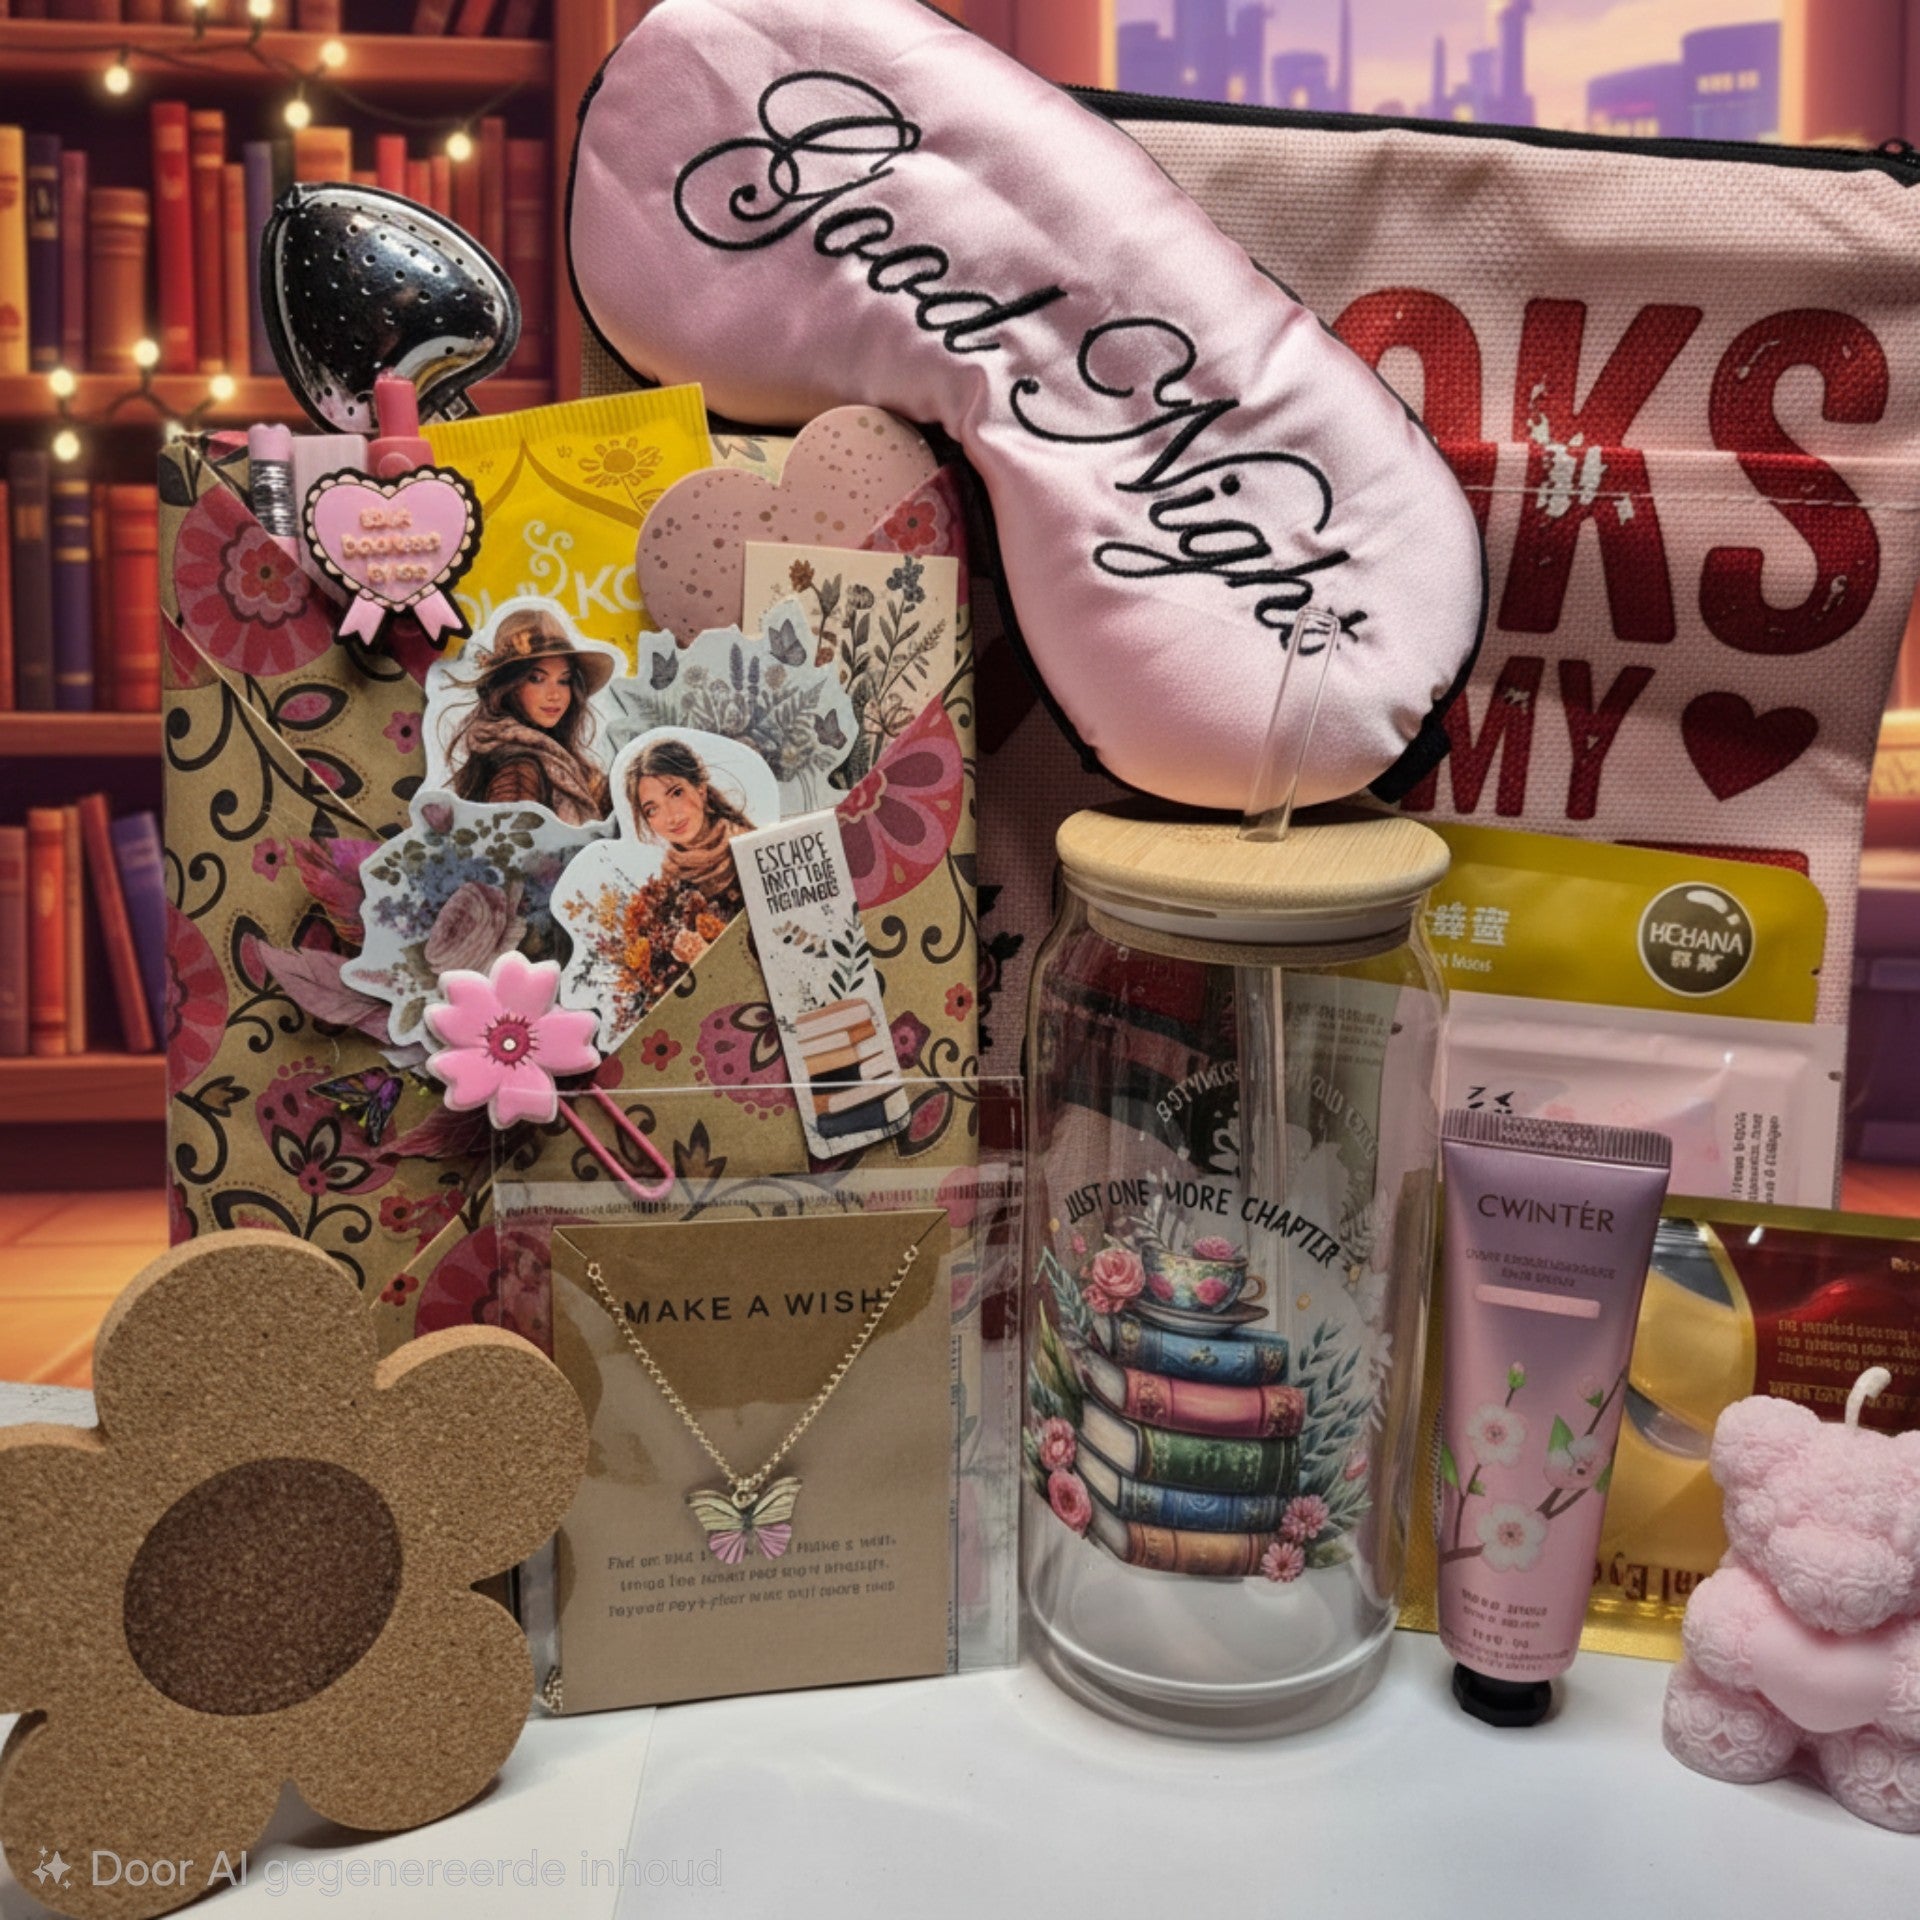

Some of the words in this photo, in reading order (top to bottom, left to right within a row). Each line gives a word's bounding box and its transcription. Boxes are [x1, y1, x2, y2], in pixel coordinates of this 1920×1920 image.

[675, 71, 1067, 354] Good
[1010, 318, 1368, 656] Night
[1400, 656, 1656, 820] MY
[1065, 1183, 1101, 1224] JUST
[1108, 1178, 1149, 1206] ONE
[1164, 1181, 1232, 1215] MORE
[1240, 1197, 1341, 1268] CHAPTER
[1477, 1194, 1615, 1234] CWINTÉR
[624, 1296, 732, 1325] MAKE
[747, 1295, 770, 1319] A
[784, 1287, 884, 1317] WISH
